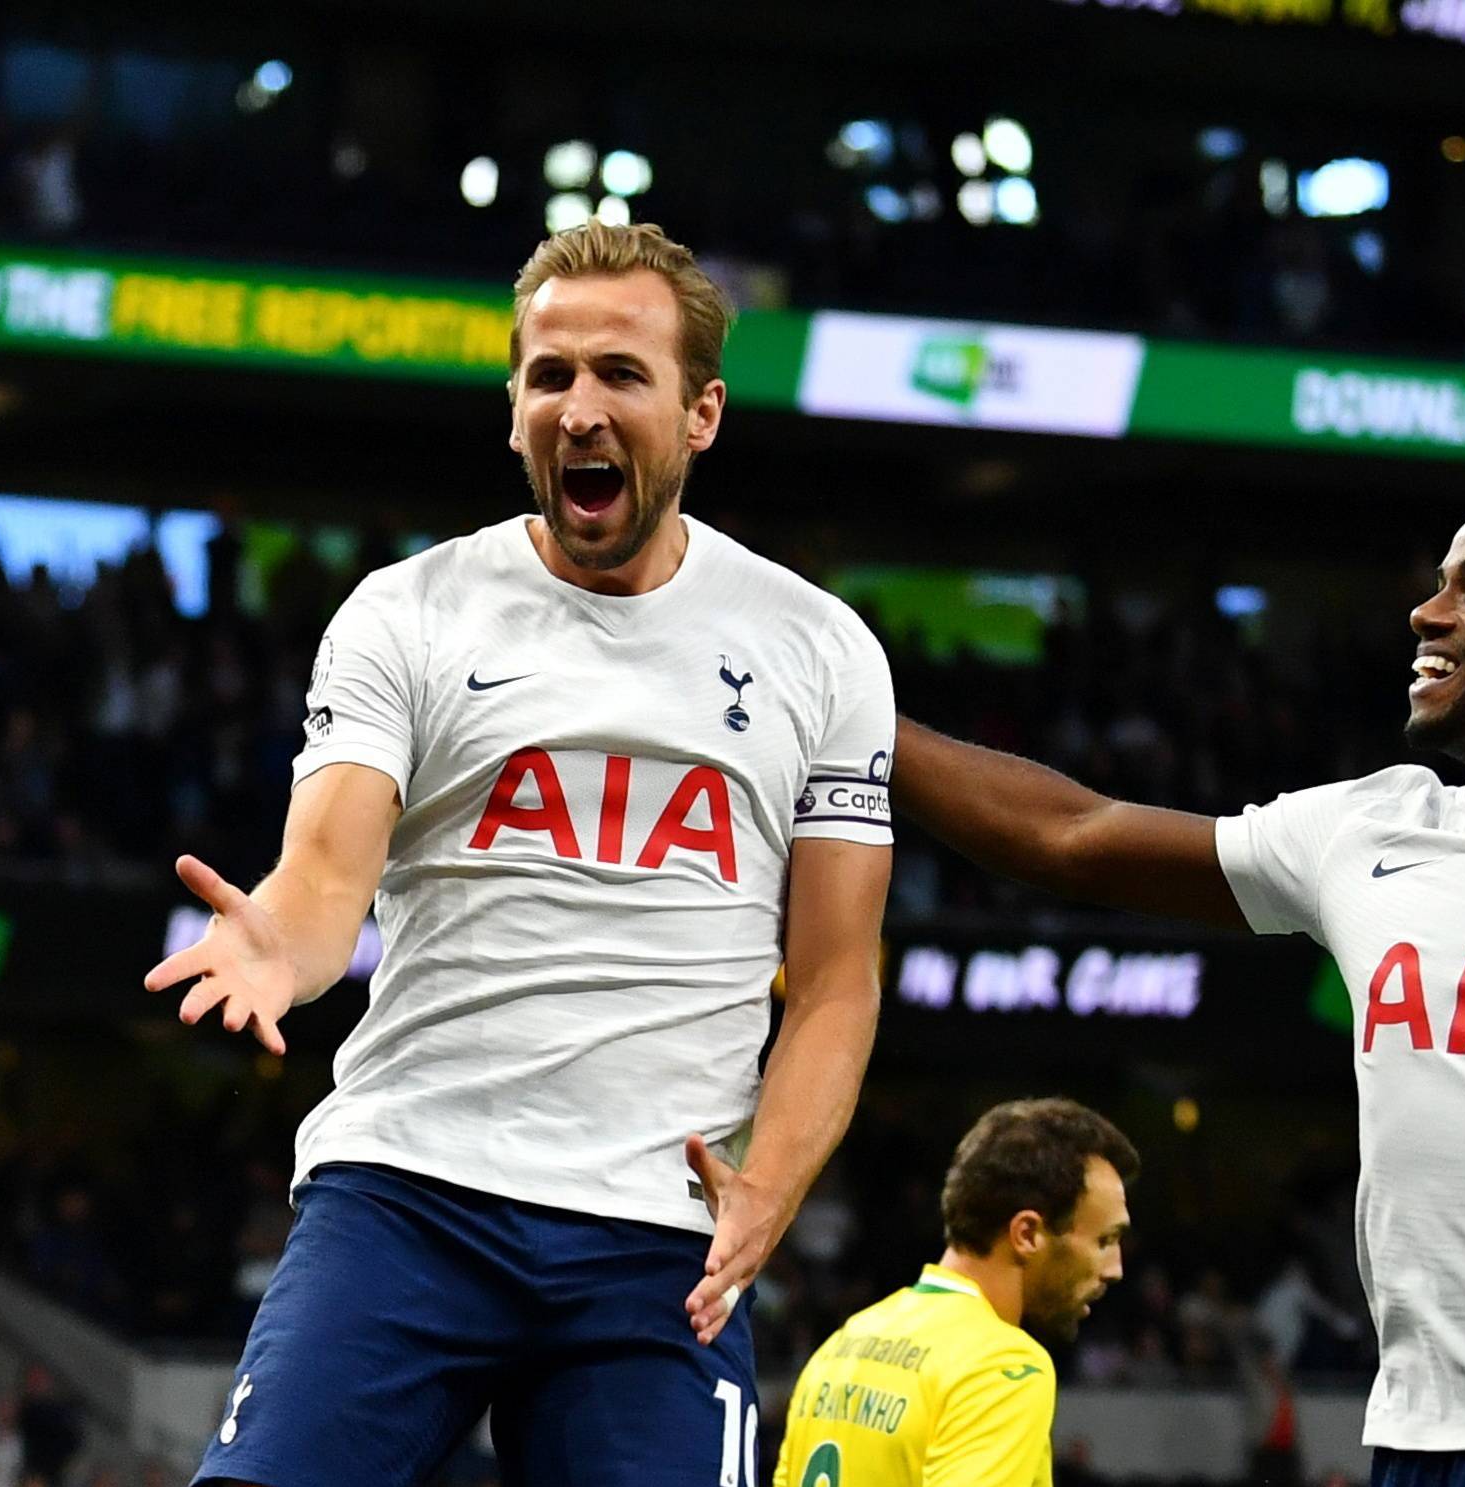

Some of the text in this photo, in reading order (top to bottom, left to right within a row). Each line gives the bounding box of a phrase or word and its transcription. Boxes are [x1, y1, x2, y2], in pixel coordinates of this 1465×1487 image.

[4, 262, 112, 340] THE
[111, 275, 247, 348] FREE
[254, 285, 516, 365] REPORTIN
[468, 746, 738, 883] AIA
